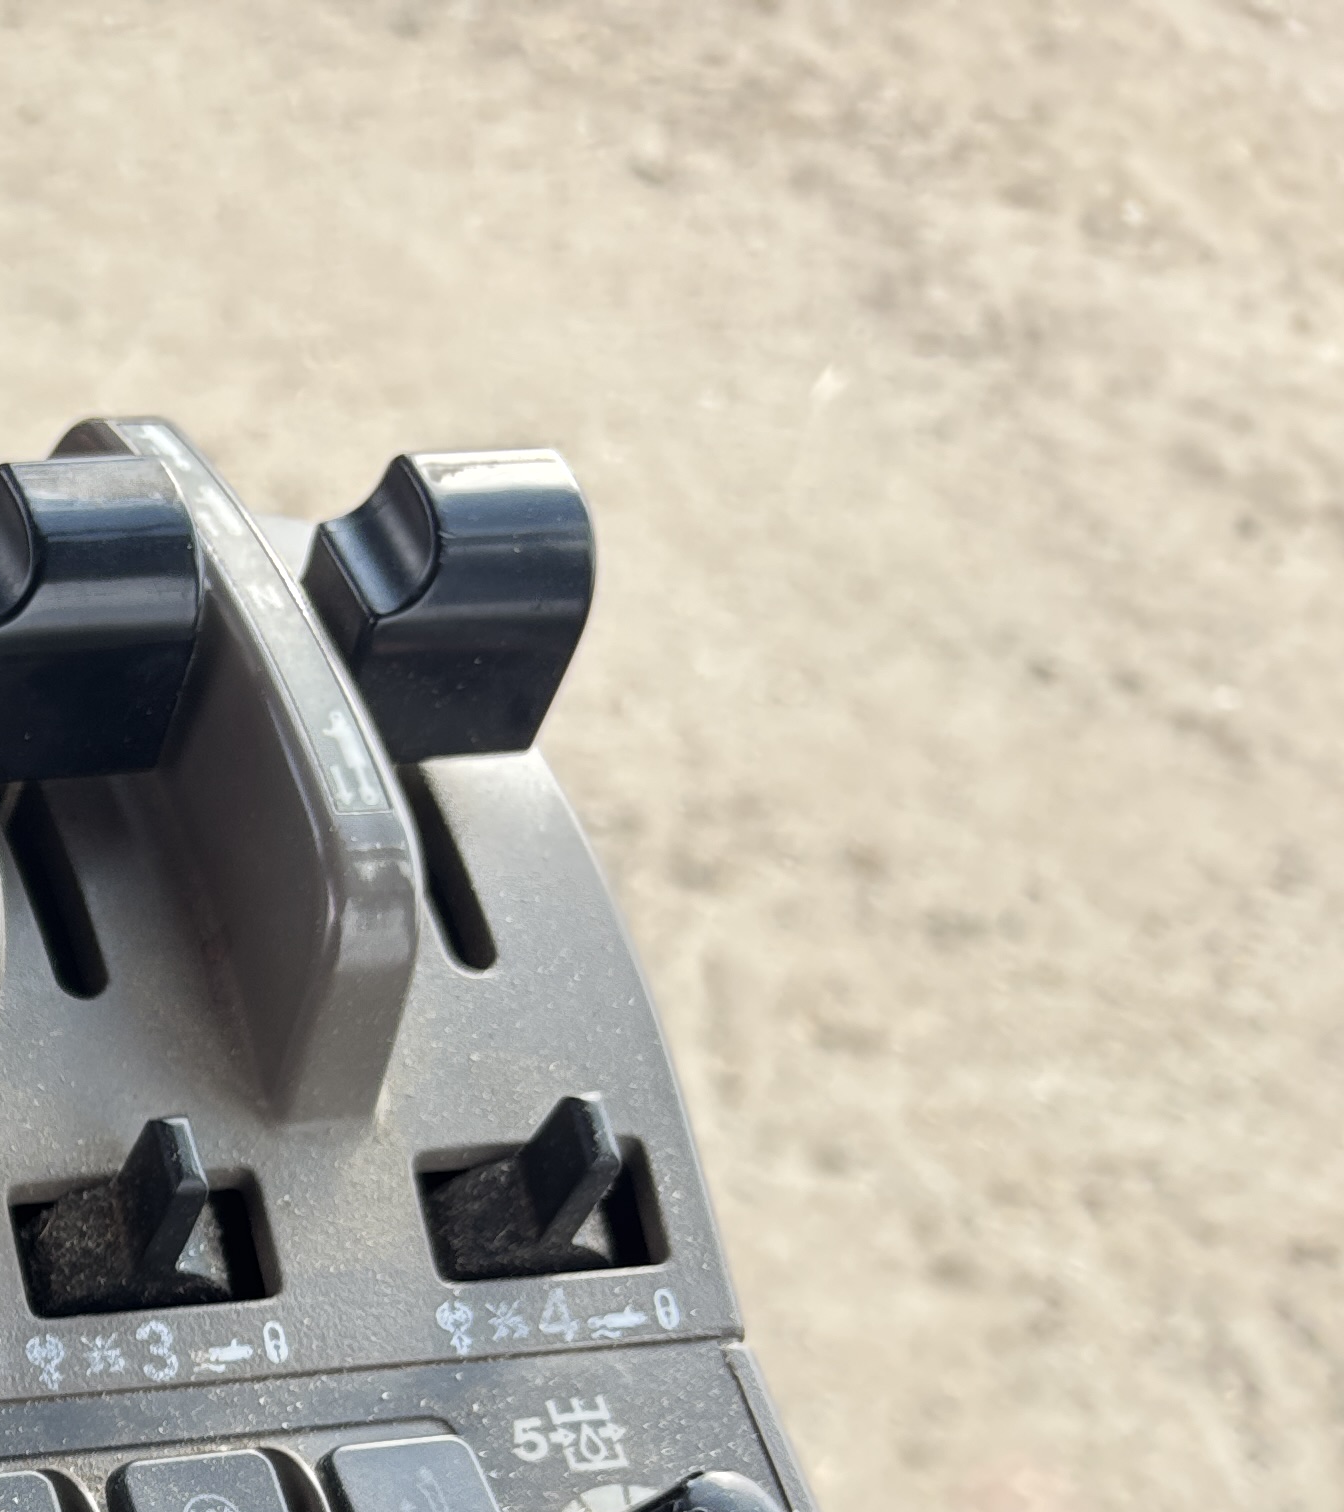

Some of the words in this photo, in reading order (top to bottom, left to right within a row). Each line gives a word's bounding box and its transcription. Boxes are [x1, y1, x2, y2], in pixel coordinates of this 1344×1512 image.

[539, 1289, 579, 1342] 4
[136, 1320, 179, 1382] 3
[513, 1417, 549, 1462] 5
